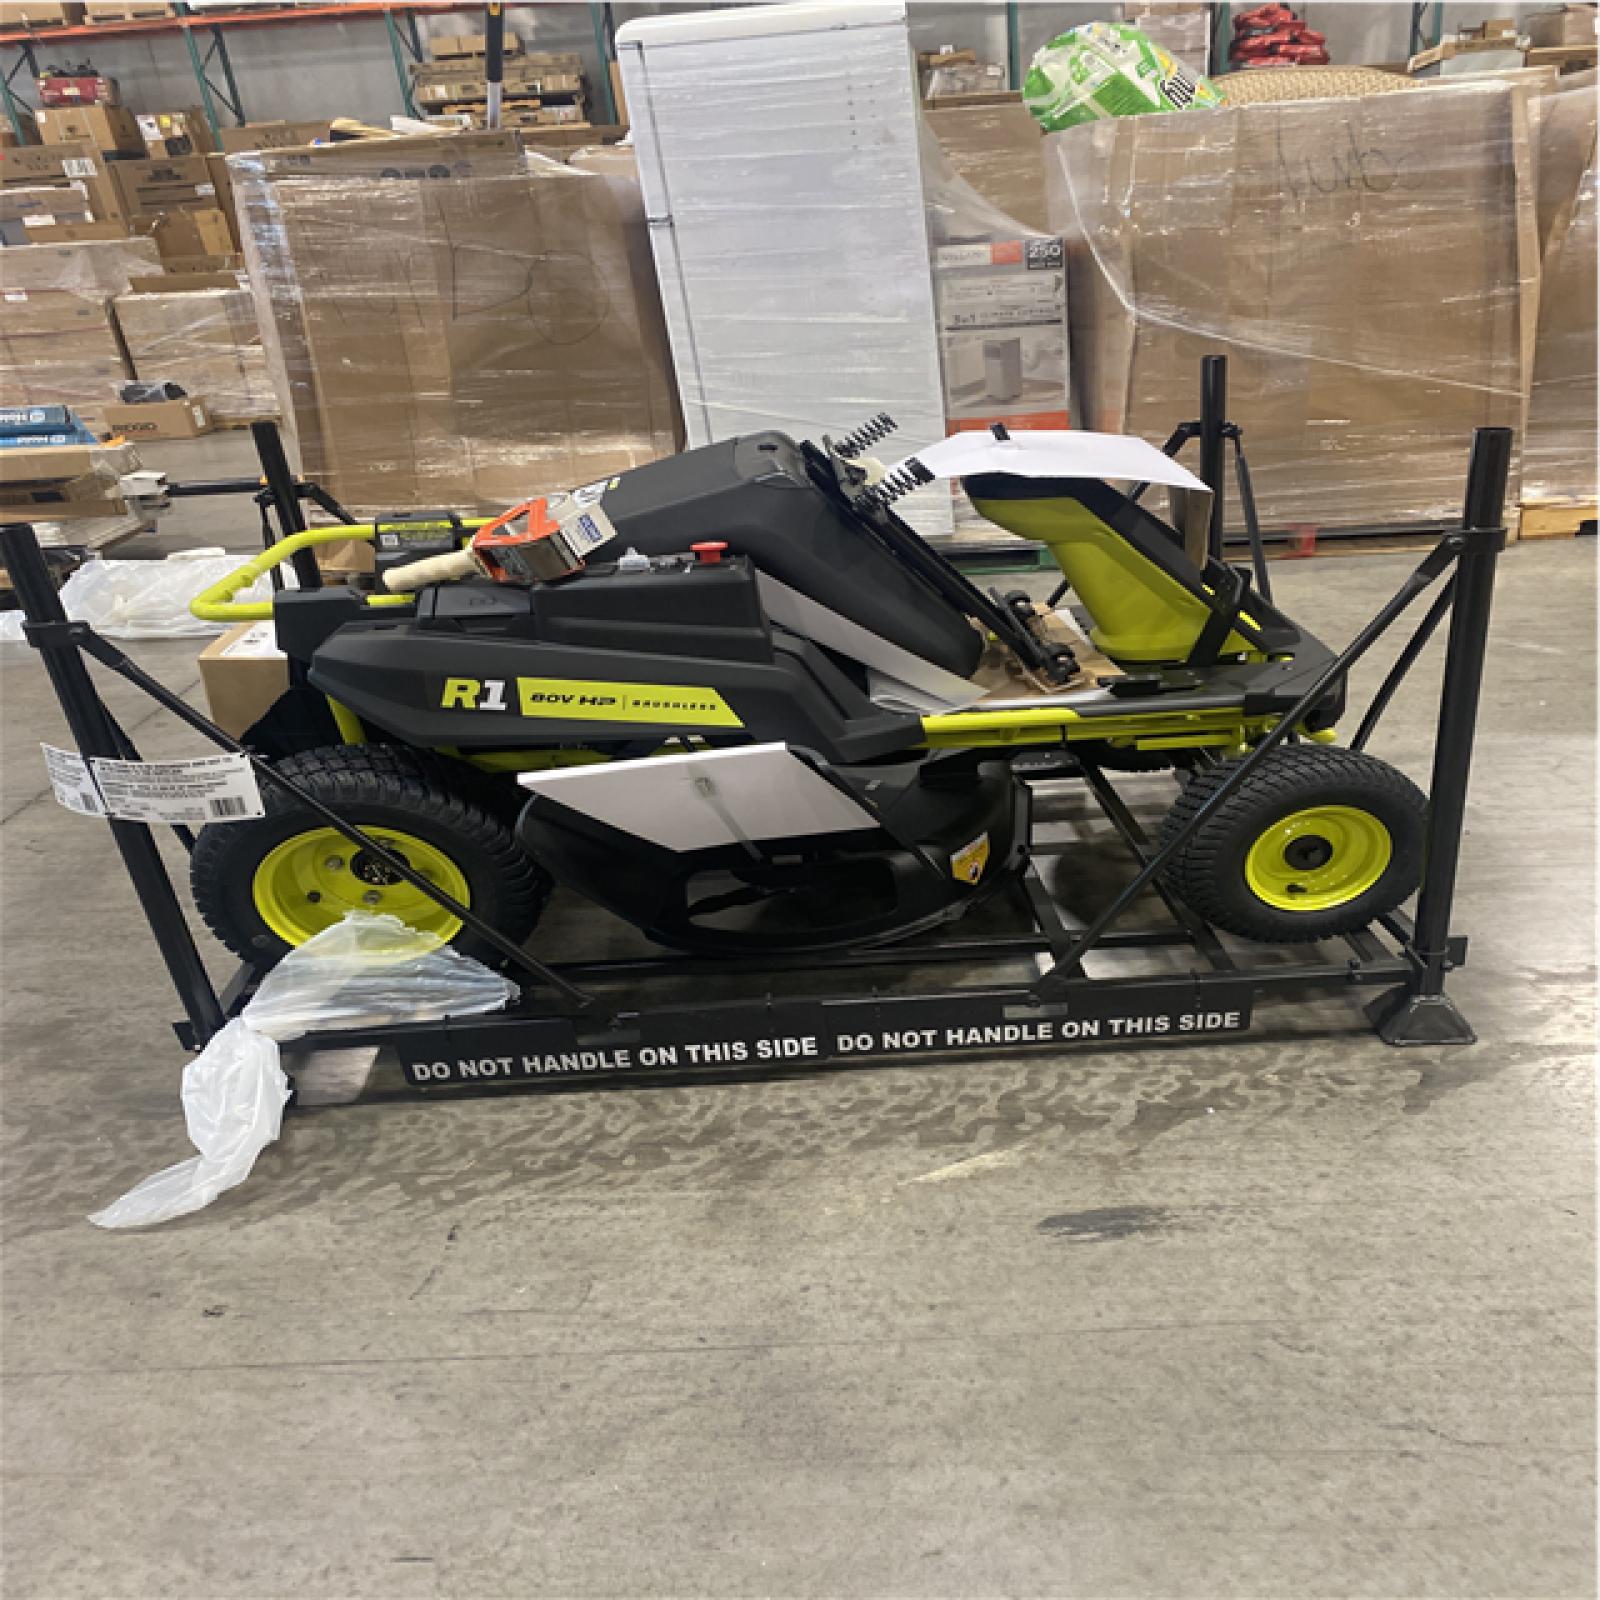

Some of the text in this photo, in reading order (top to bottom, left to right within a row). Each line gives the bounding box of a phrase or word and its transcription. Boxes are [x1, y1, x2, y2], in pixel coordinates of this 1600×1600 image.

[440, 676, 508, 711] R1
[836, 1010, 1242, 1052] DO NOT HANDLE ON THIS SIDE
[411, 1035, 819, 1081] DO NOT HANDLE ON THIS SIDE
